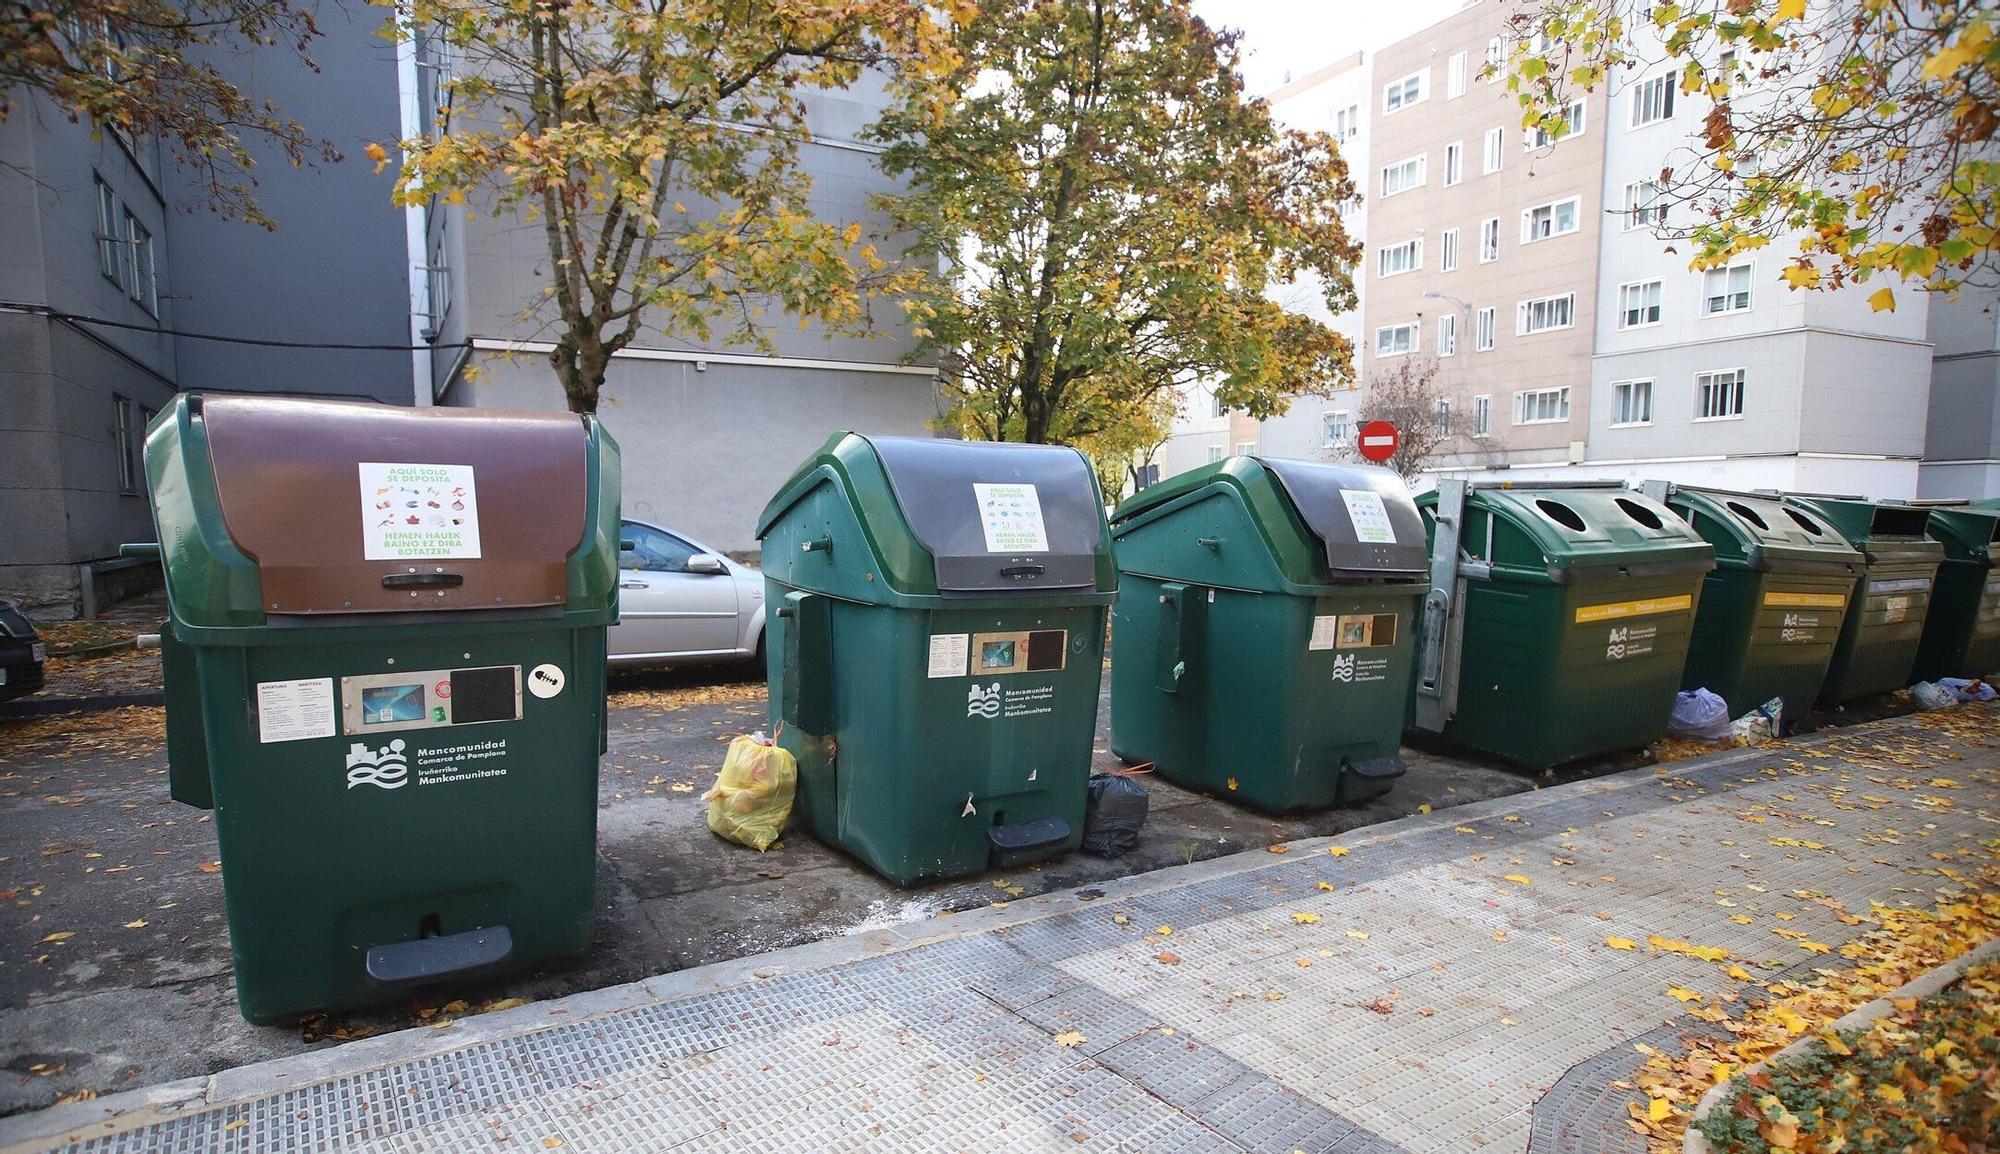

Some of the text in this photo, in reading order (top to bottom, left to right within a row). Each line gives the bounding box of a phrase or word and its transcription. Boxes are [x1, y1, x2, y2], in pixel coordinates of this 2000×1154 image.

[384, 540, 419, 548] BAINO
[1006, 686, 1052, 696] Mancomunidad
[418, 739, 506, 757] Mancomunidad
[418, 756, 453, 765] Comarca
[467, 750, 506, 759] Pamplona
[418, 766, 458, 776] Iruñerriko
[419, 769, 507, 785] Mankomunitatea
